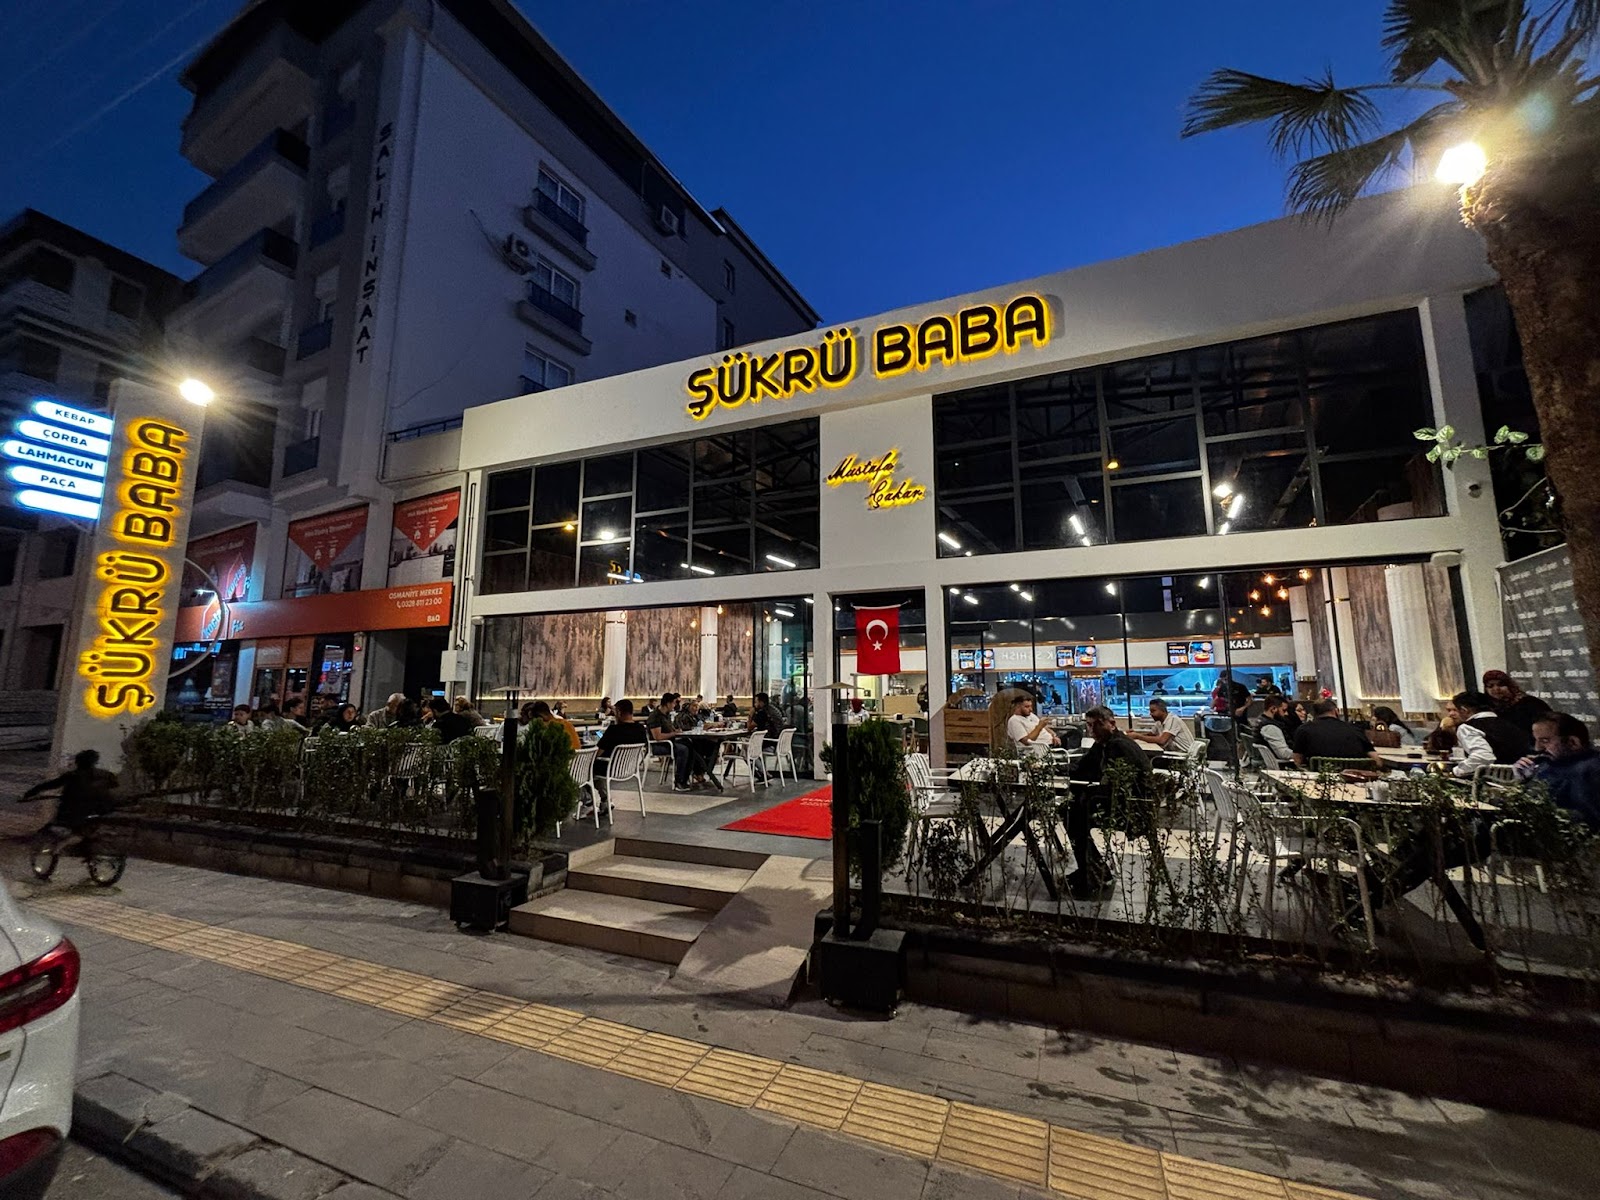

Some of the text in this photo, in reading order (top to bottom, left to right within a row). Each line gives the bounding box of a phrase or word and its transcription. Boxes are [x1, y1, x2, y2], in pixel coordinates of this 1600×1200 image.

[686, 293, 1051, 420] ŞÜKRÜ BABA
[55, 408, 95, 425] KEBAP
[43, 429, 88, 446] ÇORBA
[17, 446, 94, 470] LAHMACUN
[826, 450, 896, 484] Mustafa
[40, 474, 77, 489] PAÇA
[84, 420, 186, 716] ŞÜKRÜ BABA
[419, 587, 443, 597] MERKEZ
[425, 598, 433, 606] 23
[433, 597, 443, 605] 00
[1229, 640, 1255, 649] KASA
